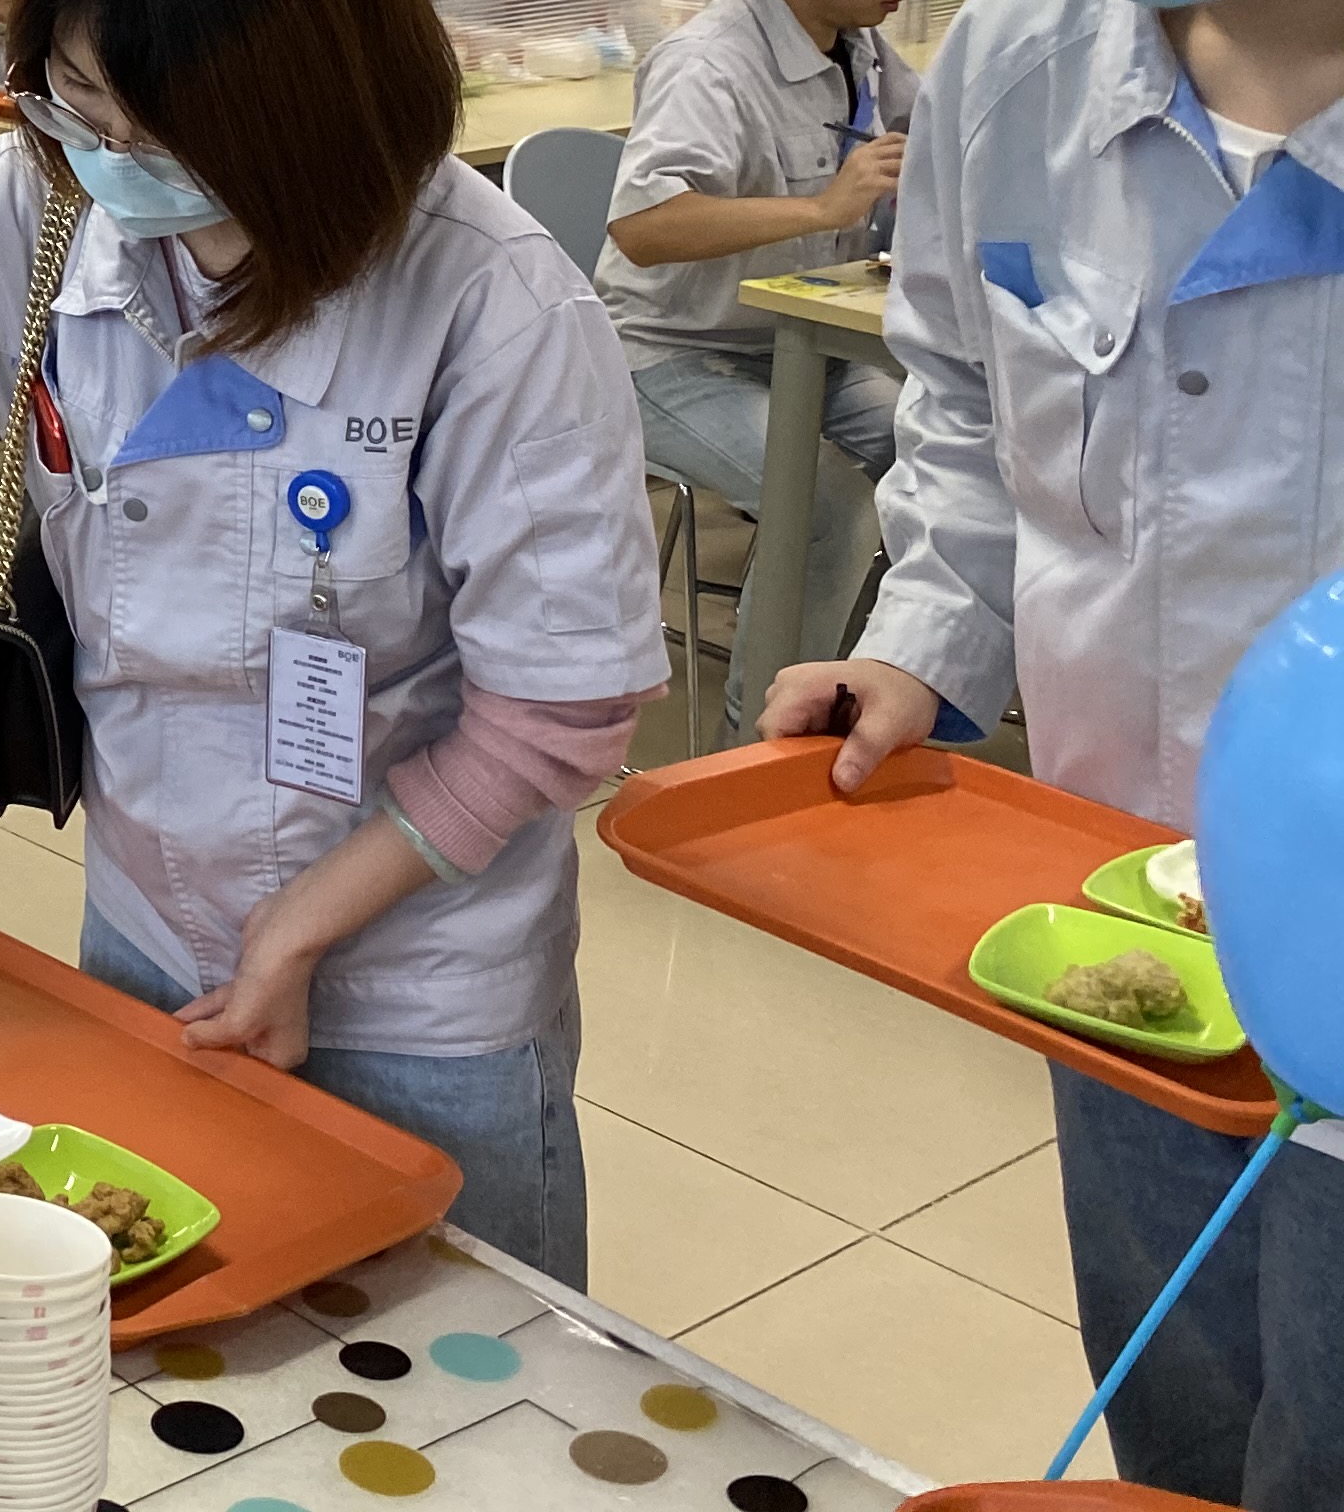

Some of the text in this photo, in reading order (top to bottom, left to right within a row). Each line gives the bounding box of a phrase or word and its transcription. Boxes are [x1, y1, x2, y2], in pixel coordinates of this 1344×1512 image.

[344, 415, 415, 453] BOE
[300, 494, 326, 511] BOE
[337, 649, 360, 663] BOE
